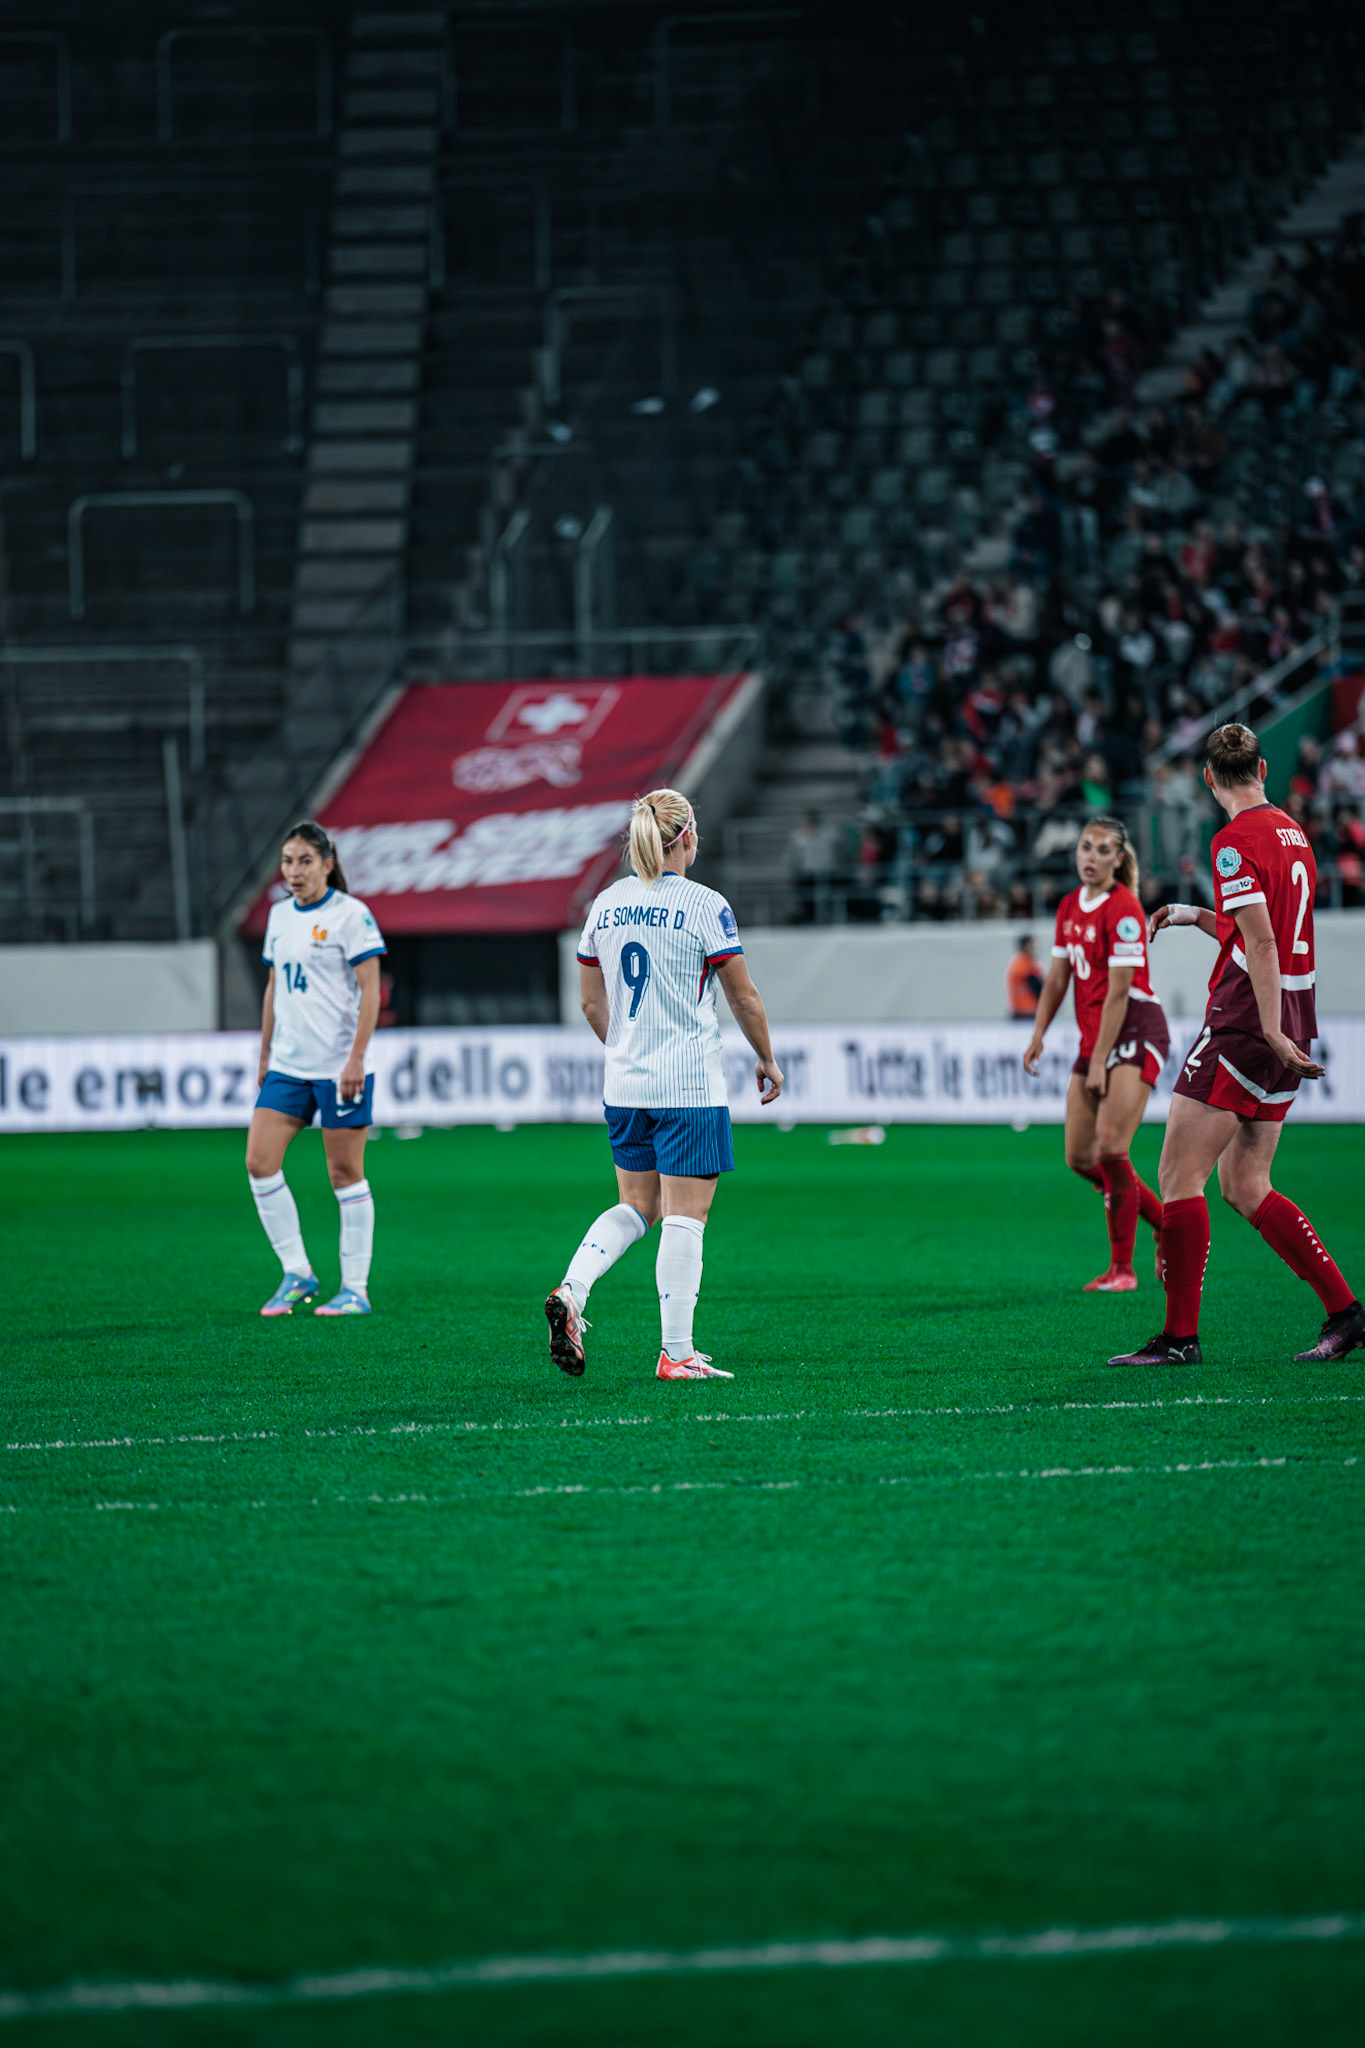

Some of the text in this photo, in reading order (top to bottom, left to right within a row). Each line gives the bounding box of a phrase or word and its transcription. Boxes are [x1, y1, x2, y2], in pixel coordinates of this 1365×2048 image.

[597, 905, 685, 930] LE SOMMER D
[1291, 860, 1310, 955] 2
[283, 962, 308, 994] 14
[620, 941, 650, 1021] 9
[1186, 1026, 1212, 1067] 2
[75, 1065, 247, 1112] emoz
[389, 1045, 529, 1102] dello
